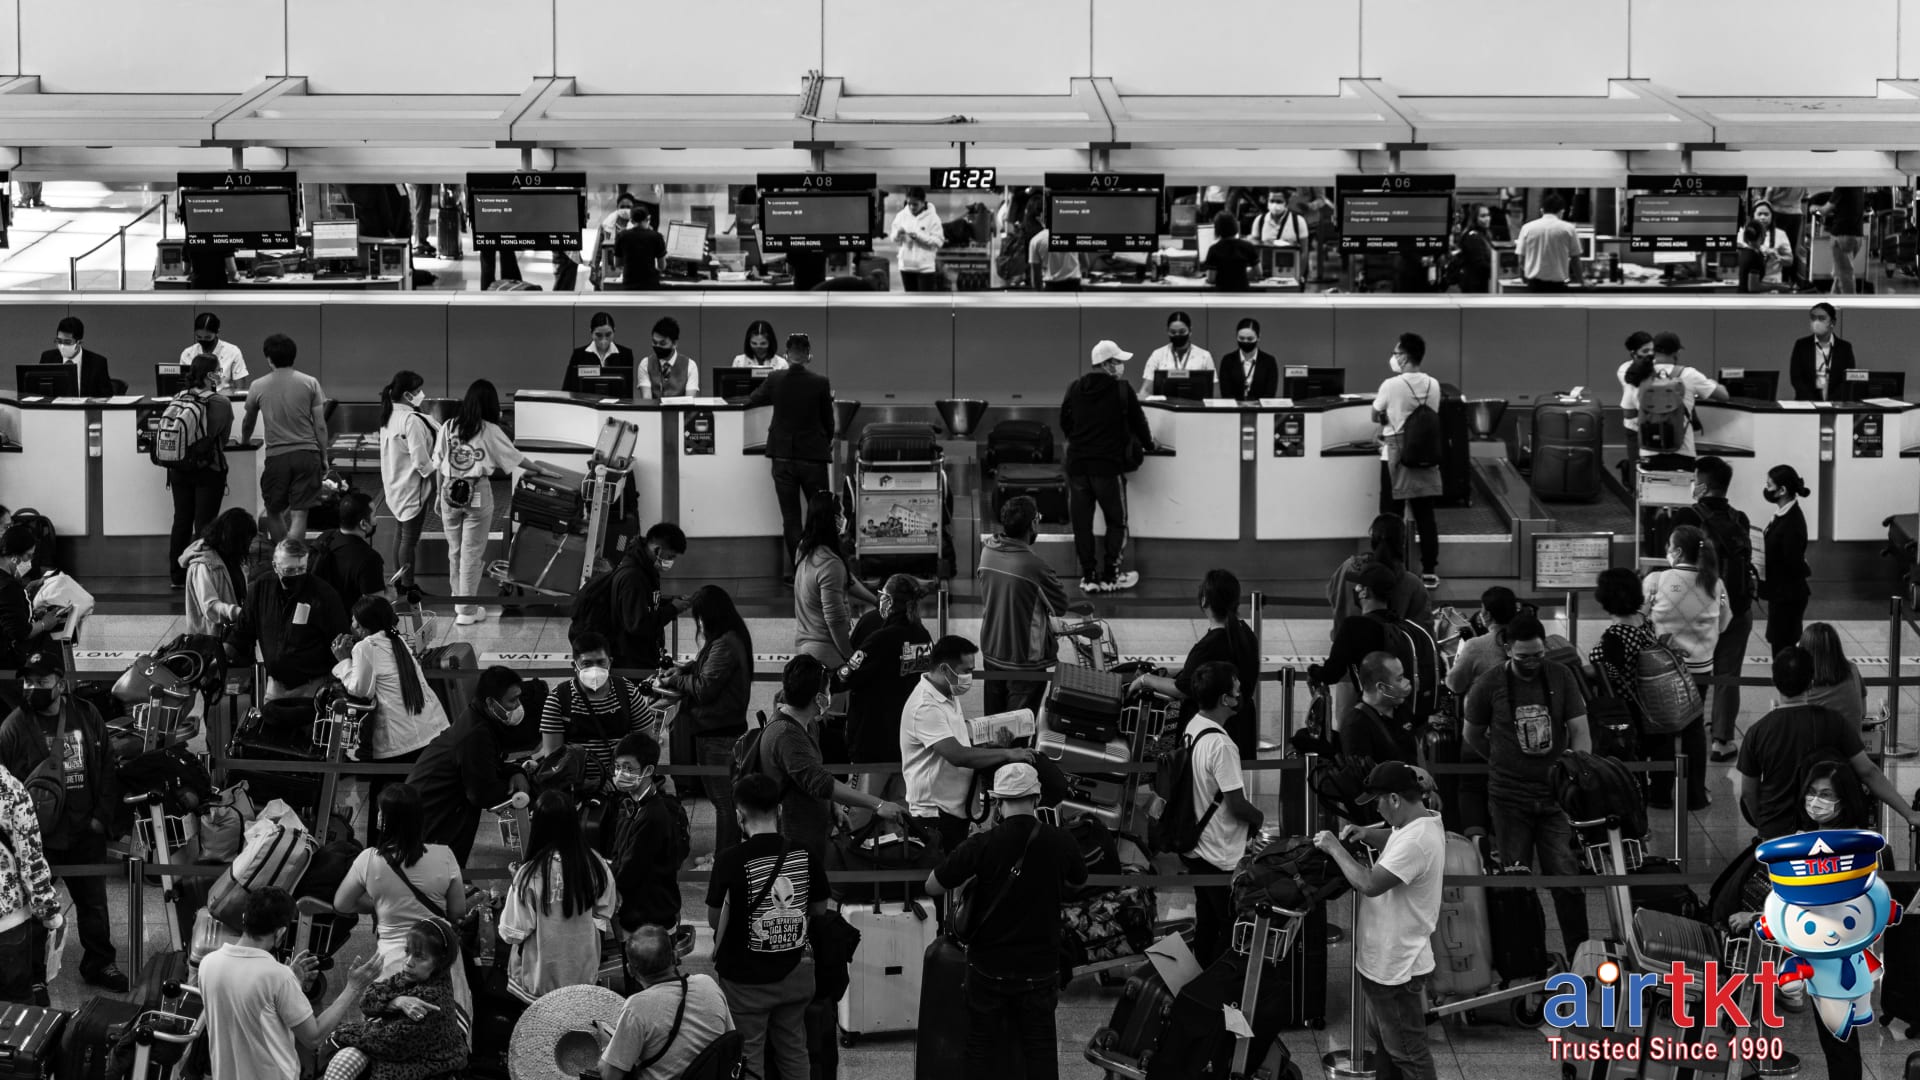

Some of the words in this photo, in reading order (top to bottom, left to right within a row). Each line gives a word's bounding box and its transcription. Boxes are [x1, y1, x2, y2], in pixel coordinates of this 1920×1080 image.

[225, 175, 234, 184] A
[238, 175, 251, 184] 10
[512, 175, 521, 185] A
[525, 175, 541, 185] 09
[803, 176, 812, 186] A
[816, 176, 832, 186] 08
[942, 170, 994, 188] 15:22
[1091, 176, 1100, 186] A
[1104, 176, 1119, 186] 07
[1382, 178, 1390, 187] A
[1395, 178, 1411, 187] 06
[1674, 178, 1682, 188] A
[1686, 178, 1702, 188] 05
[784, 924, 798, 933] SAFE
